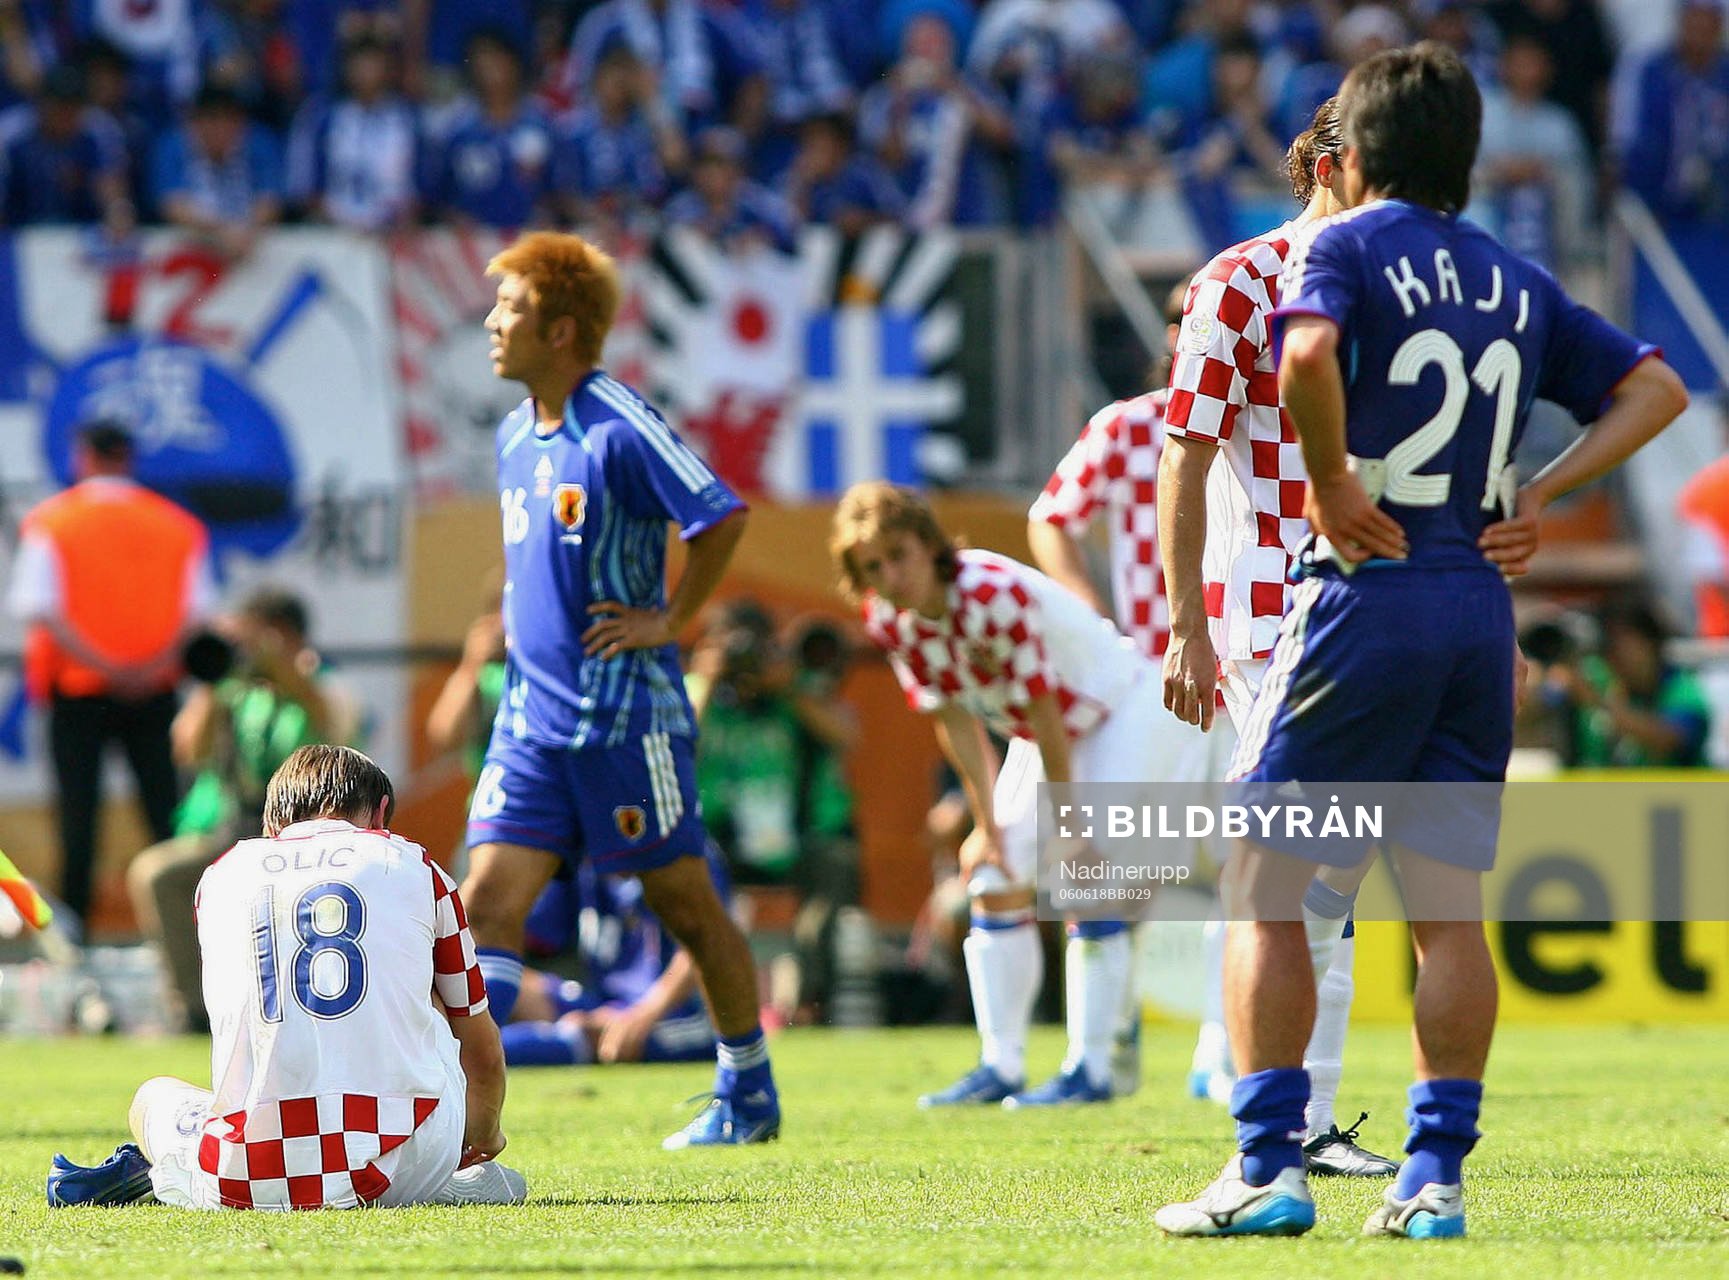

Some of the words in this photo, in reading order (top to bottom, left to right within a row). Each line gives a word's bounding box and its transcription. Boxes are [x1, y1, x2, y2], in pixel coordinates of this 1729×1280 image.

[1384, 248, 1529, 333] KAJI
[1386, 328, 1521, 512] 21
[501, 486, 529, 546] 16
[262, 847, 355, 873] OLIC
[252, 879, 368, 1025] 18
